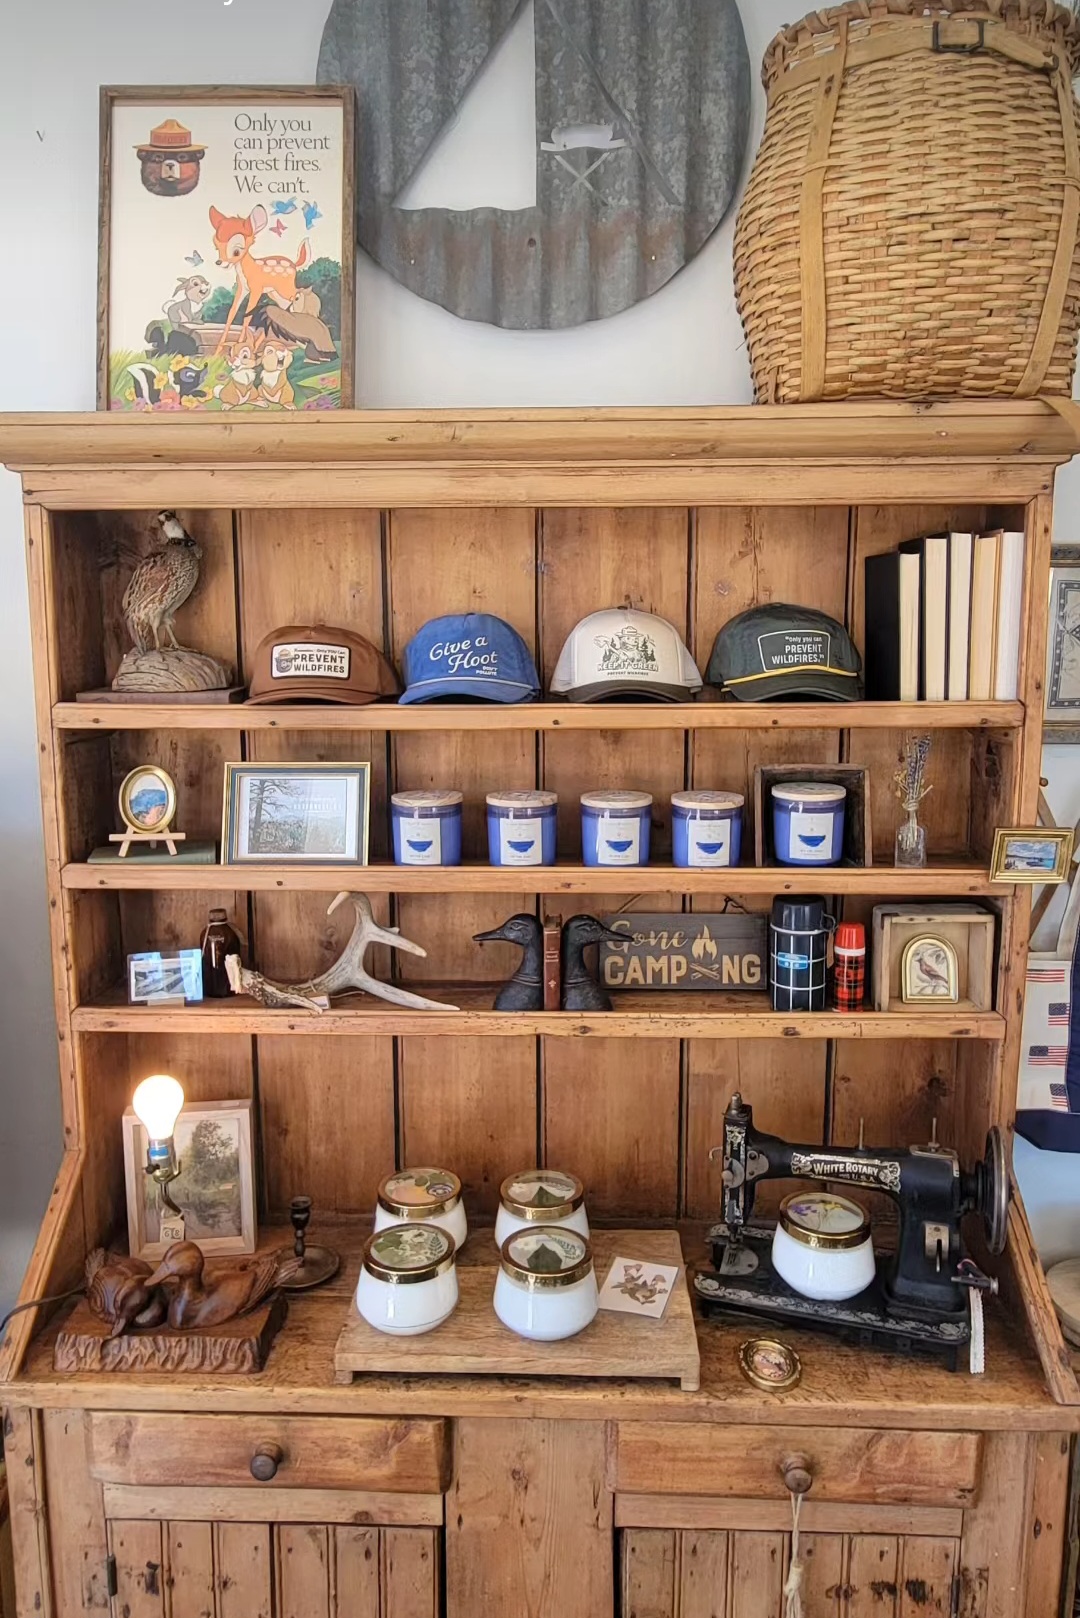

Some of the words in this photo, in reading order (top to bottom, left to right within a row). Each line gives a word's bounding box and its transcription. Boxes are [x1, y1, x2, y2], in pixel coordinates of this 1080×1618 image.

[234, 112, 277, 137] Only
[280, 119, 312, 137] you
[233, 137, 263, 150] can
[266, 135, 331, 155] prevent
[233, 151, 280, 171] forest
[284, 151, 322, 171] fires.
[233, 174, 263, 194] We
[267, 176, 309, 194] can't.
[429, 639, 471, 661] Give
[474, 636, 488, 647] a
[784, 643, 823, 654] PREVENT
[293, 653, 346, 665] PREVENT
[293, 663, 345, 674] WILDFIRES
[447, 650, 498, 674] Hoot
[597, 662, 618, 672] KEEP
[619, 662, 631, 671] IT
[631, 662, 659, 672] GREEN
[606, 920, 689, 954] Gone
[813, 1161, 845, 1175] WHITE
[845, 1162, 879, 1177] ROTARY
